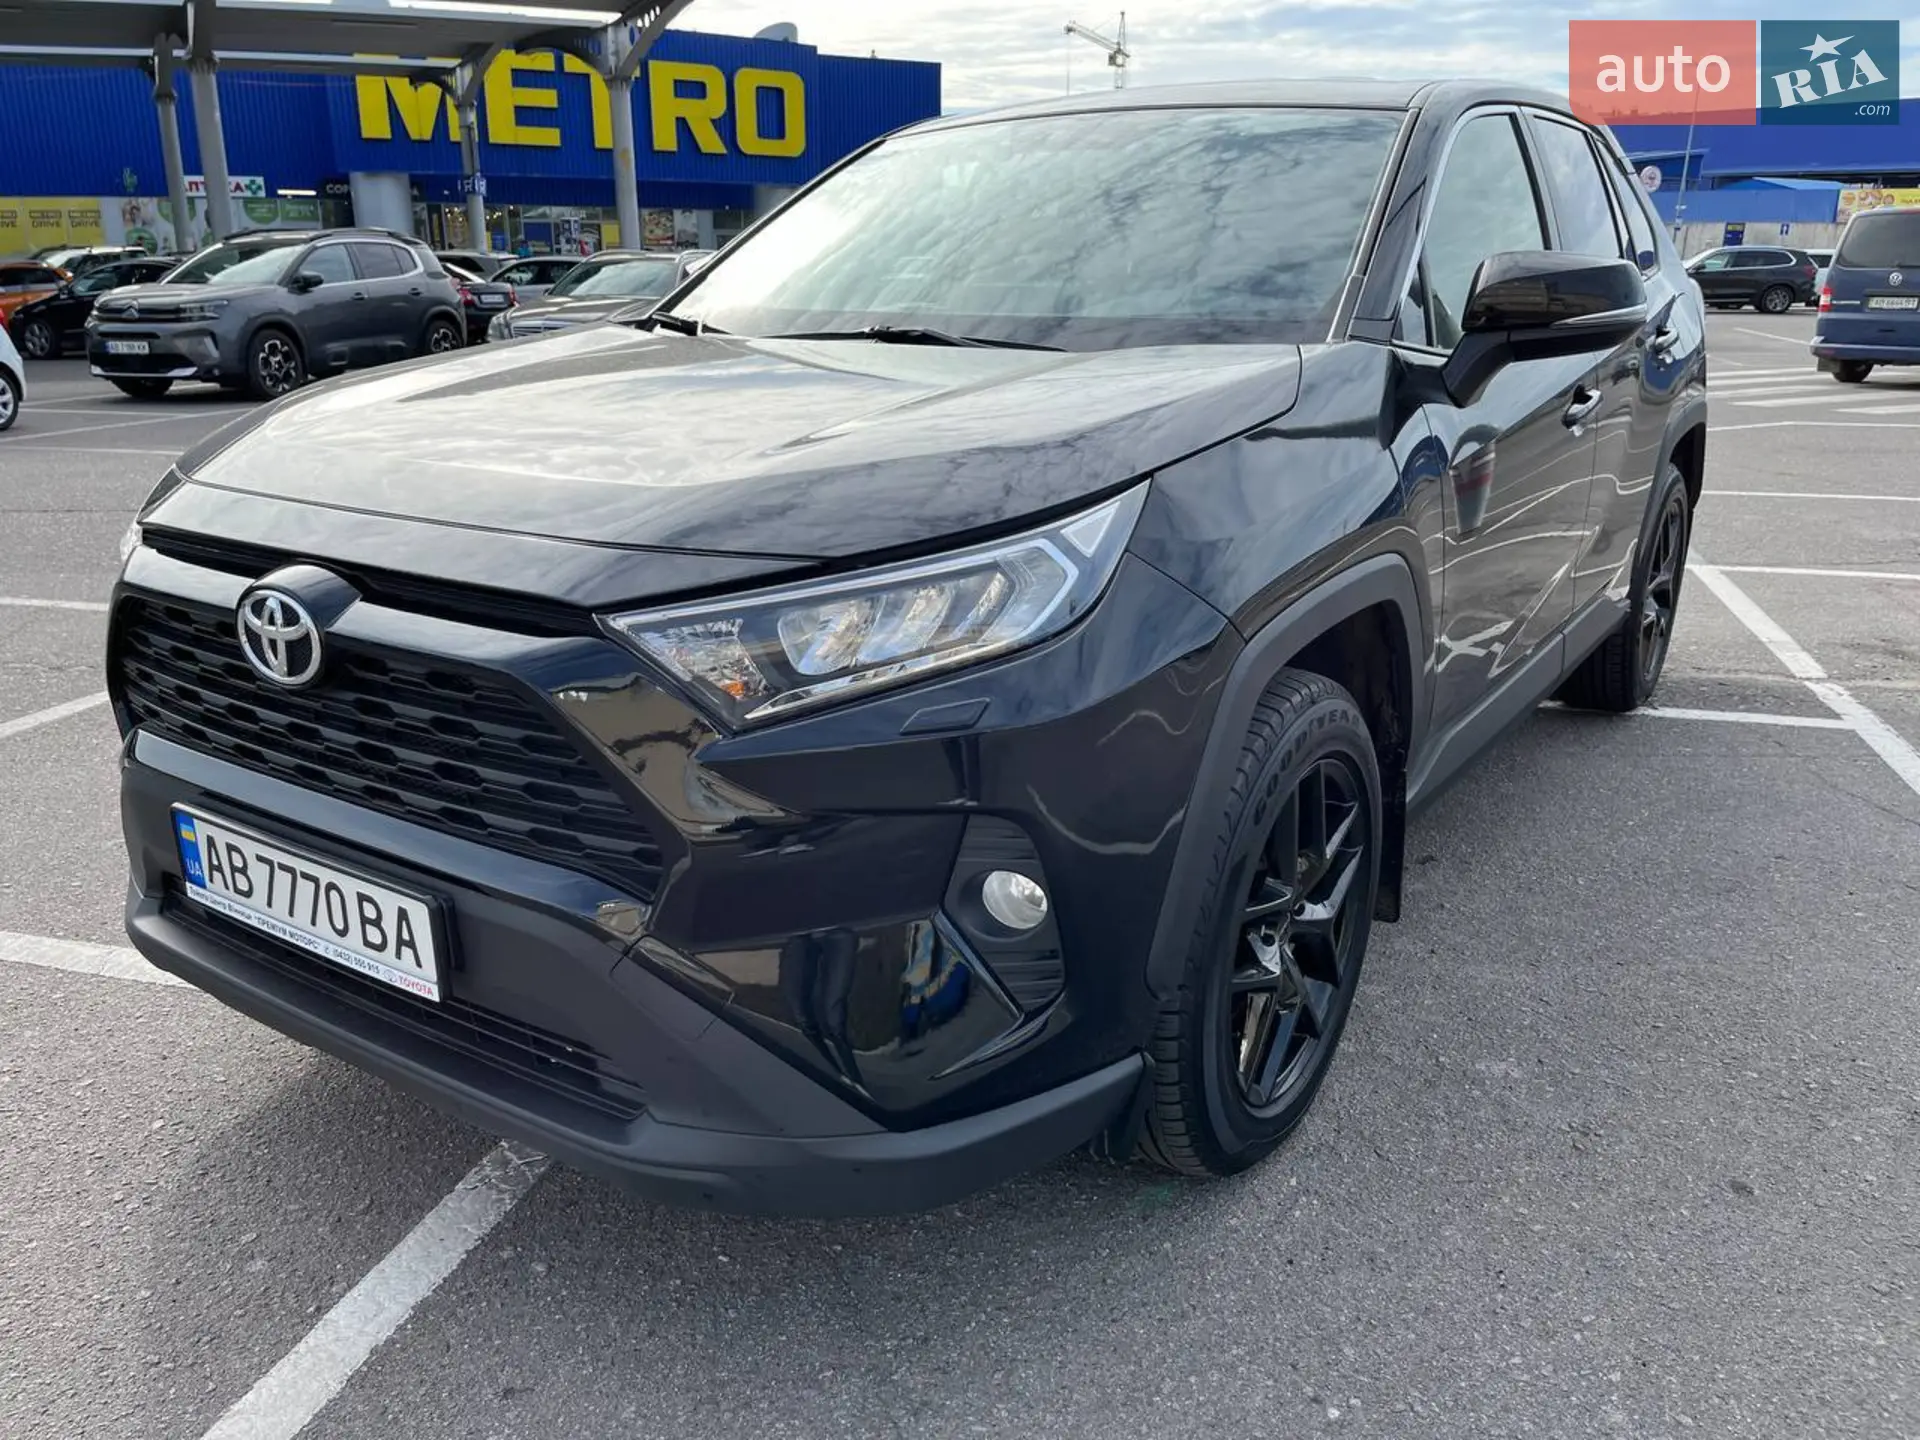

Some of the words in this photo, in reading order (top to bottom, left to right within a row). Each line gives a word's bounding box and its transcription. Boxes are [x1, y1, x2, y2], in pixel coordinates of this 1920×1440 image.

[354, 49, 805, 157] METRO
[186, 860, 203, 876] UA
[398, 974, 434, 996] TOYOTA
